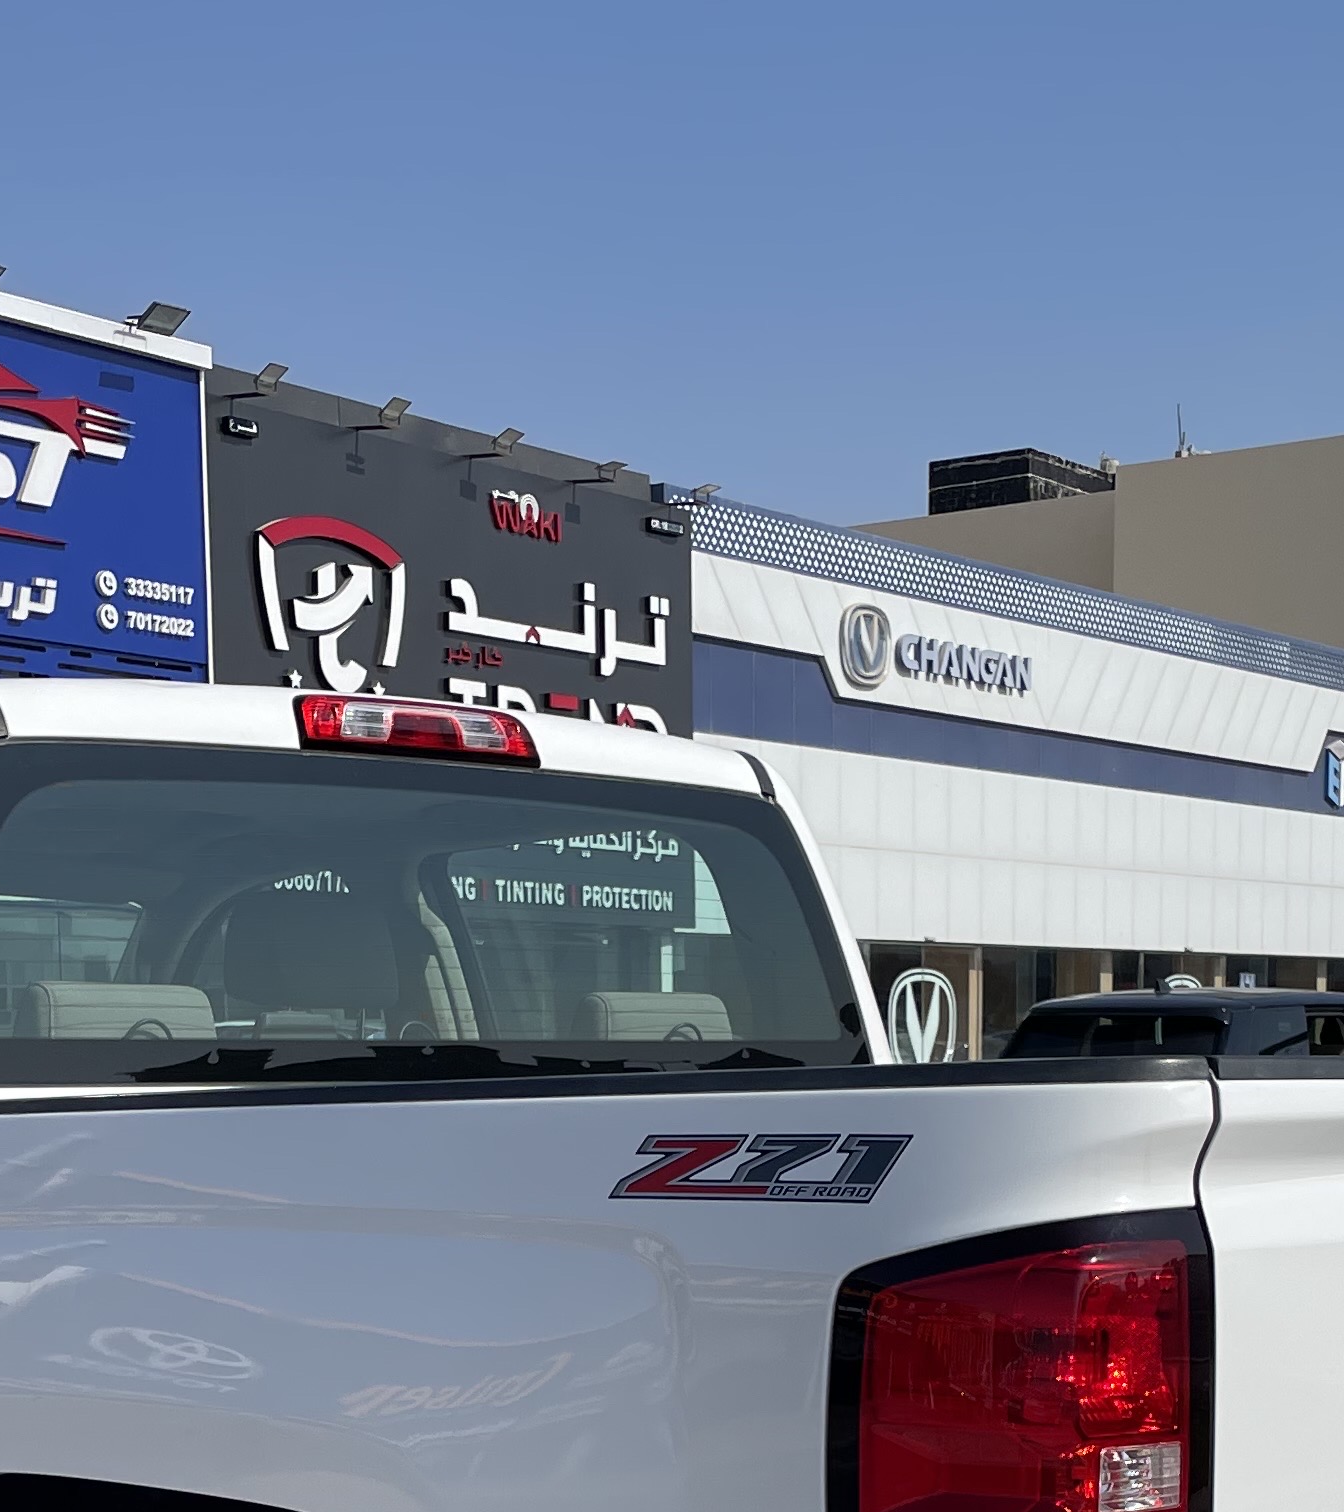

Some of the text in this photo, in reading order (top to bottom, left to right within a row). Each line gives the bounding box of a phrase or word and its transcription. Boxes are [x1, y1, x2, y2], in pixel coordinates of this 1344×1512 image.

[124, 577, 194, 605] 33335117
[126, 610, 194, 638] 70172022
[897, 634, 1032, 692] CHANGAN
[495, 879, 565, 906] TINTING
[582, 885, 674, 912] PROTECTION
[609, 1134, 913, 1202] Z71
[770, 1184, 871, 1199] OFF ROAD
